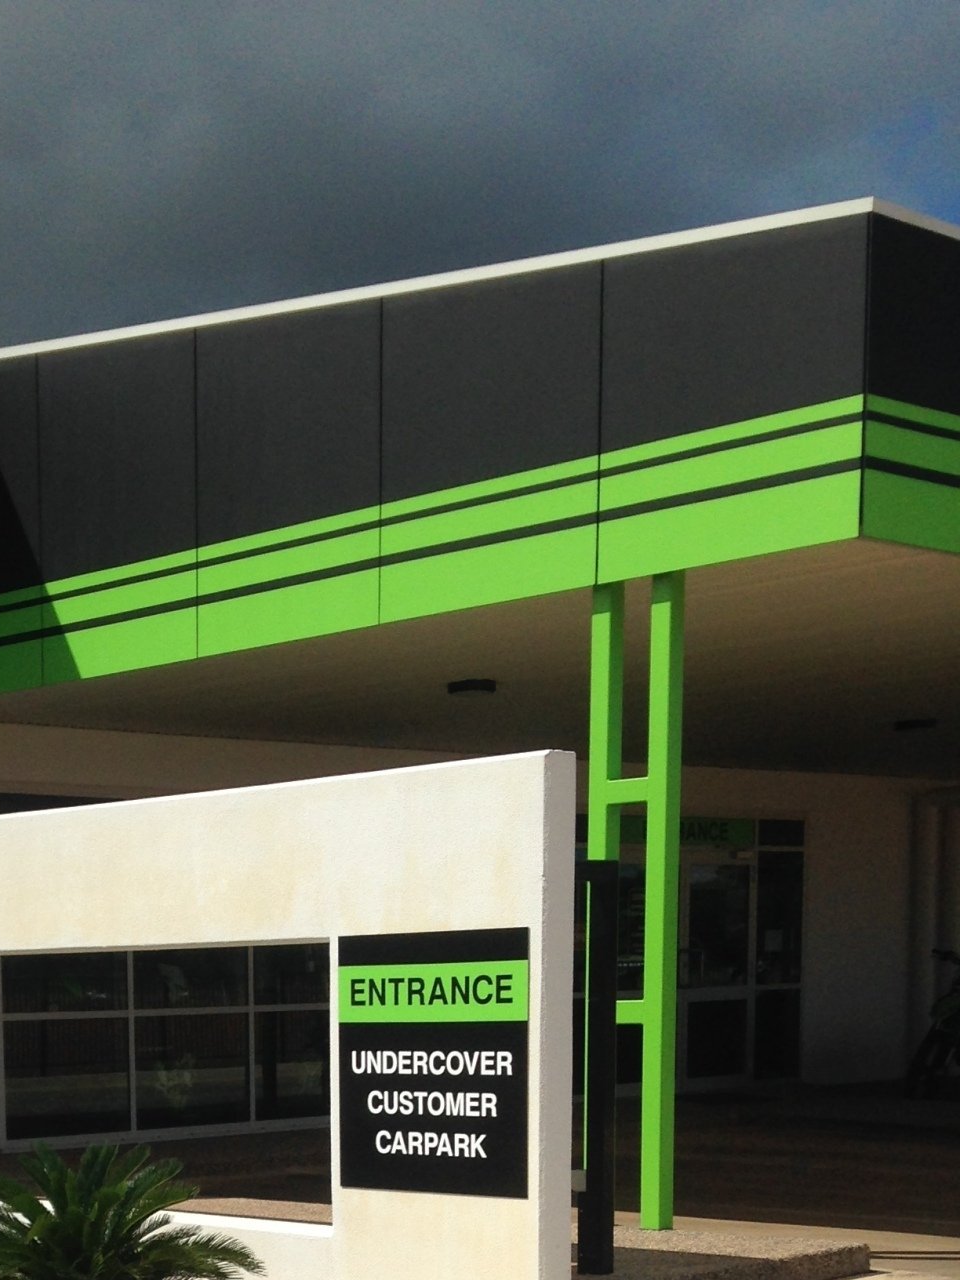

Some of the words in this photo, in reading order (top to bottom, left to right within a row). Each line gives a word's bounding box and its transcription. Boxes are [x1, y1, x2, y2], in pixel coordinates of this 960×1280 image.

[350, 974, 513, 1006] ENTRANCE
[351, 1050, 513, 1076] UNDERCOVER
[367, 1090, 497, 1117] CUSTOMER
[375, 1130, 487, 1158] CARPARK
